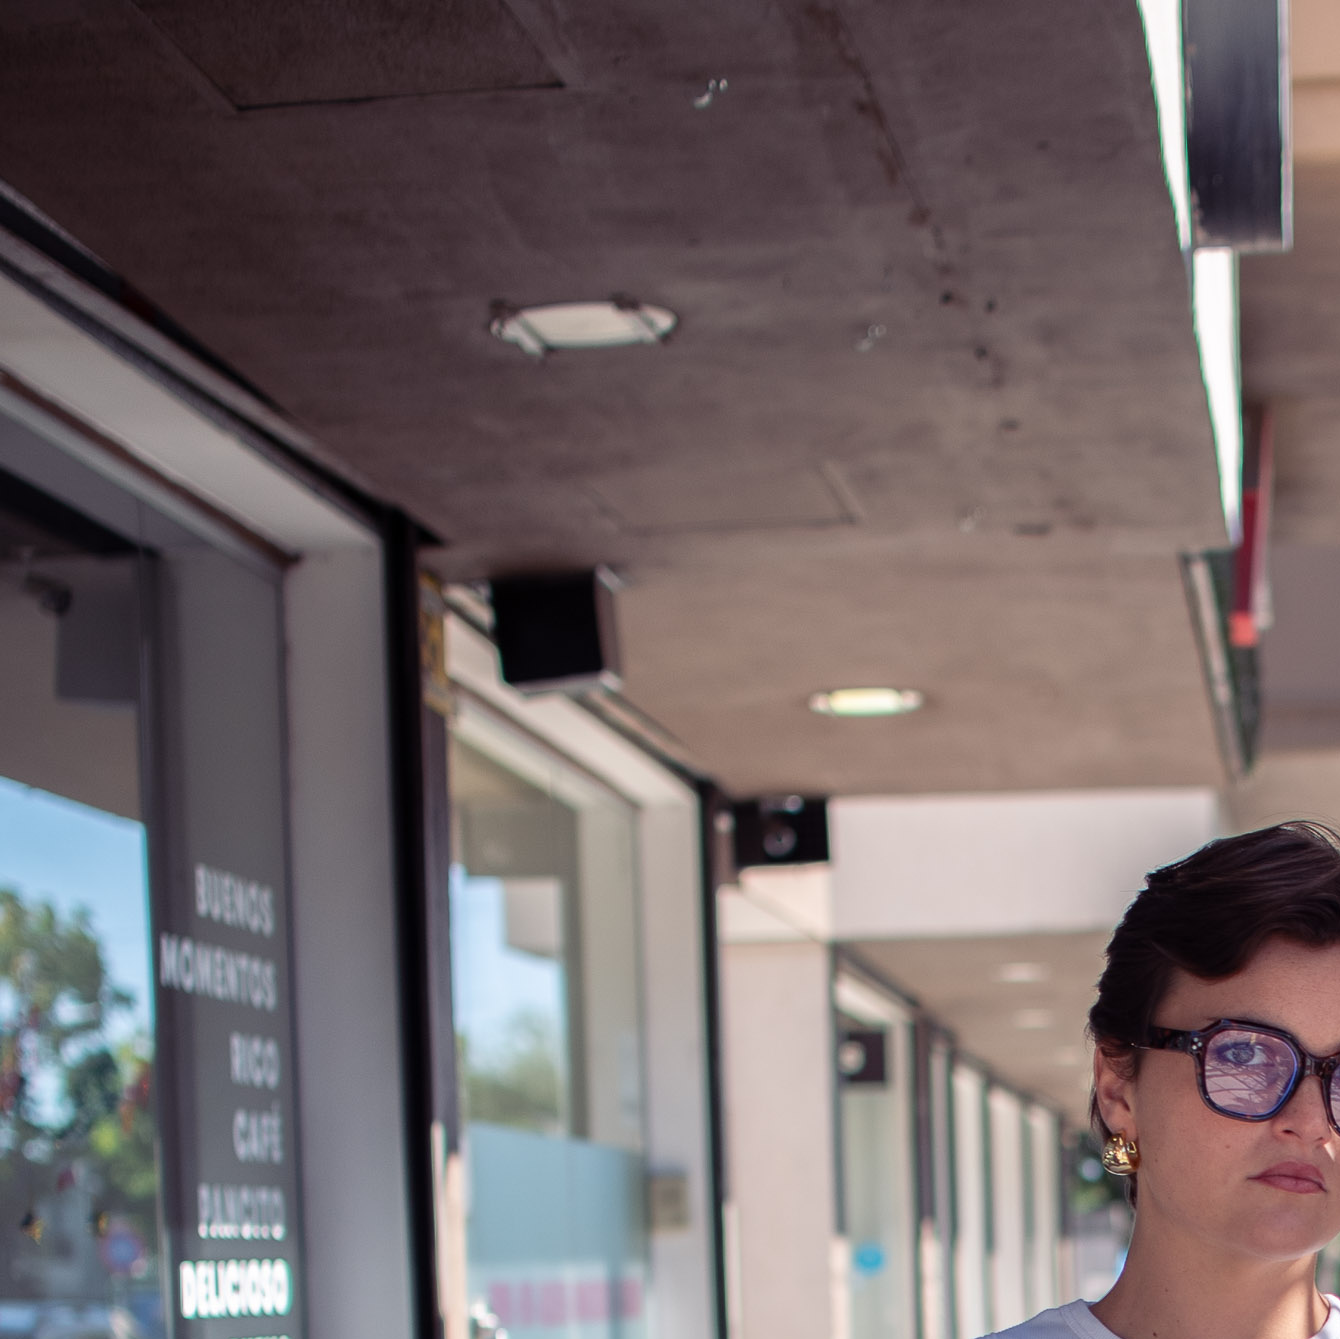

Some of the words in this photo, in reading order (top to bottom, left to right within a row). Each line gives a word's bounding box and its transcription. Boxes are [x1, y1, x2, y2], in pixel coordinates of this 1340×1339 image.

[195, 863, 275, 938] BUENOS
[160, 931, 277, 1013] MOMENTOS
[230, 1031, 281, 1089] RICO
[233, 1100, 283, 1165] CAFÉ
[180, 1258, 293, 1319] DELICIOSO
